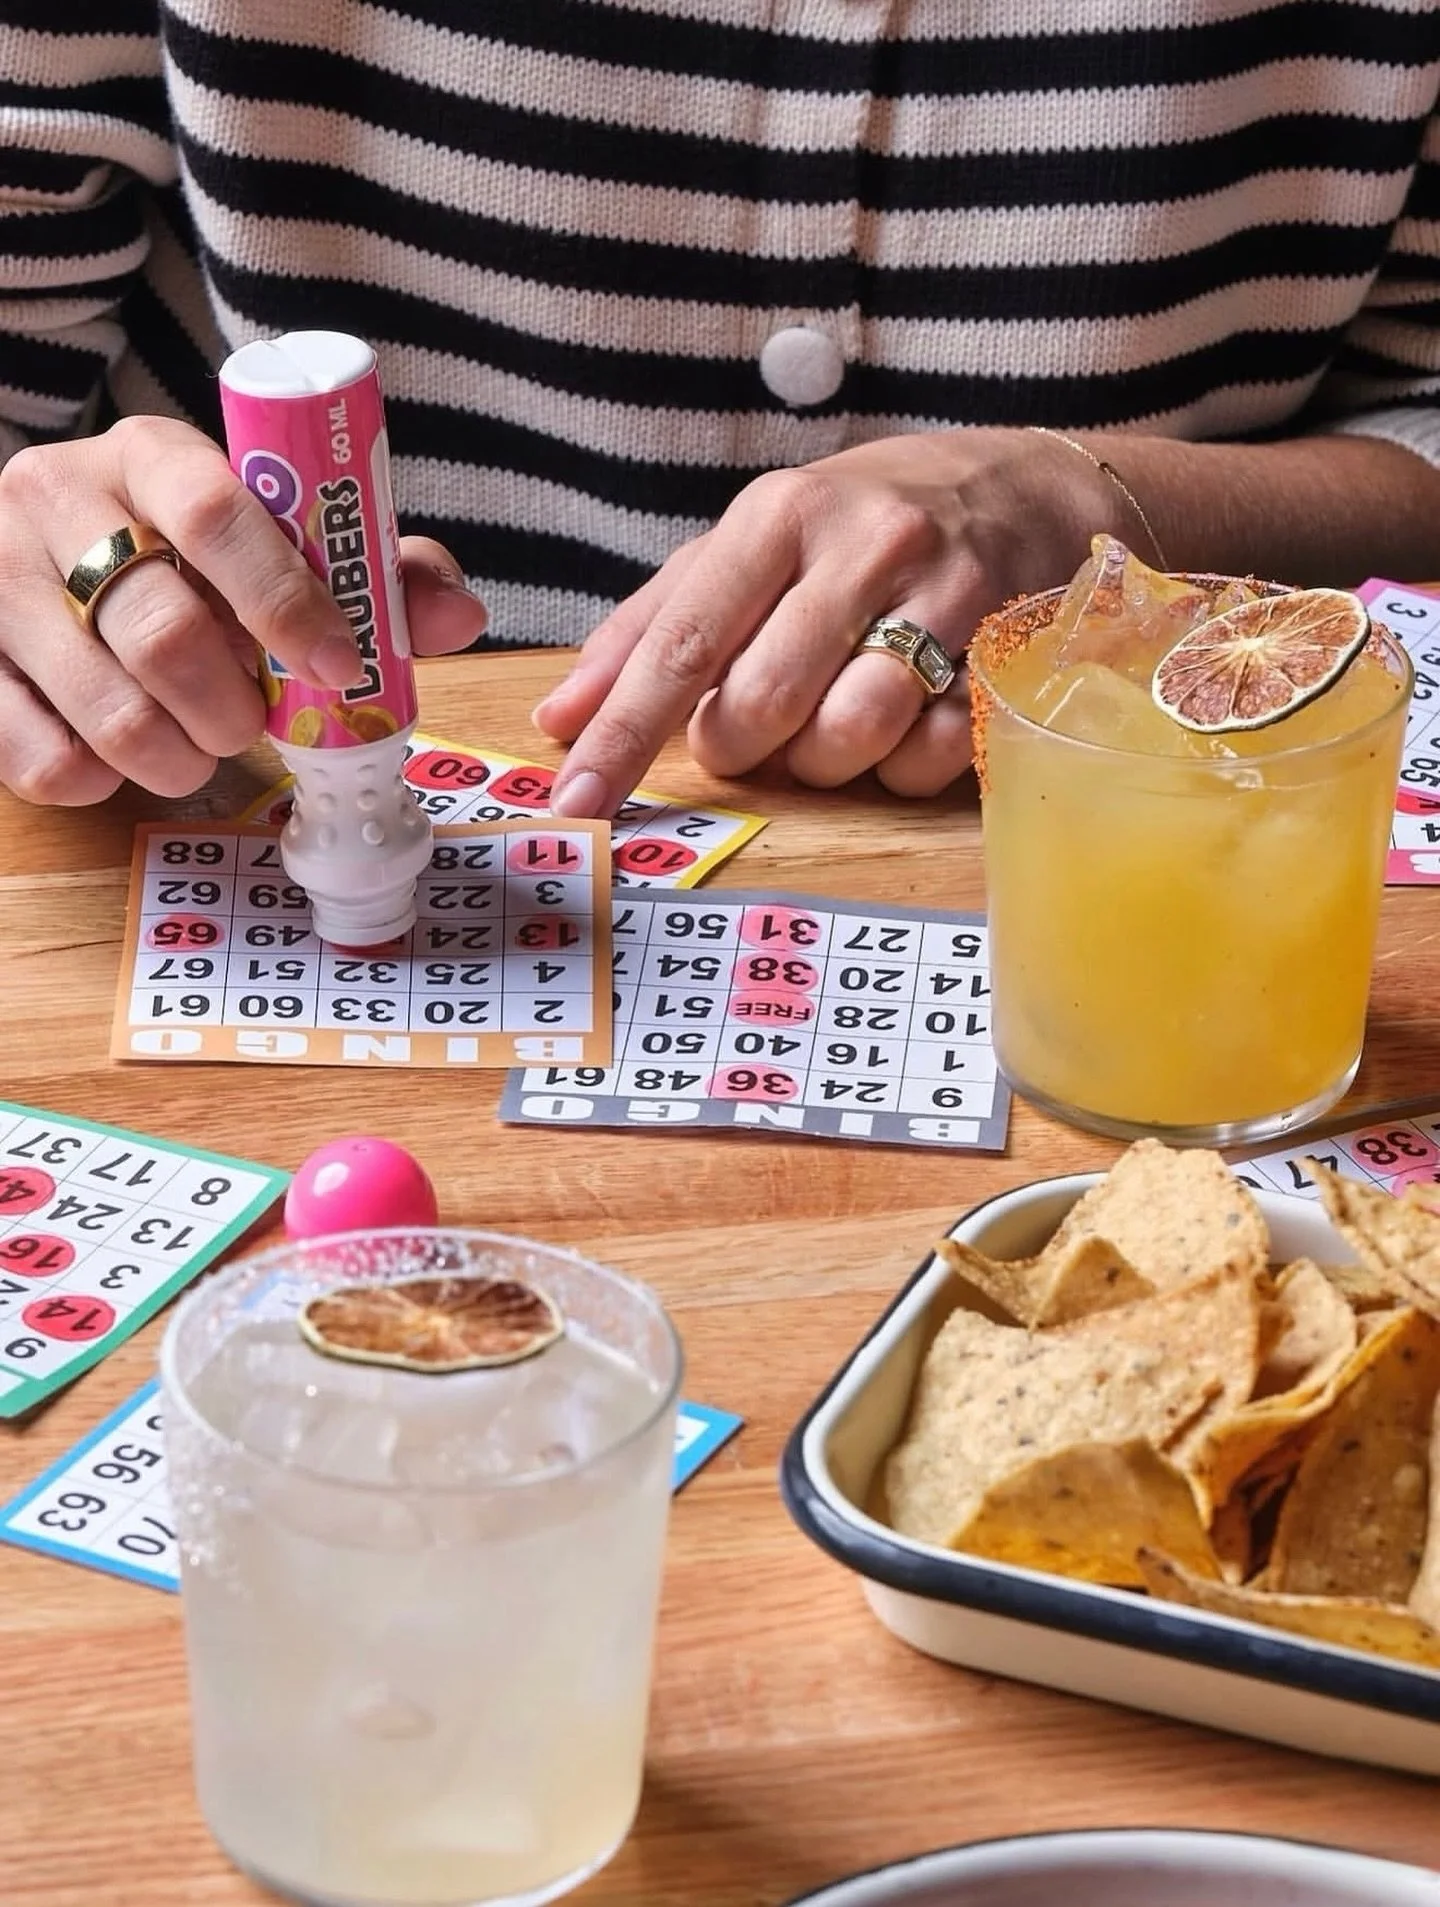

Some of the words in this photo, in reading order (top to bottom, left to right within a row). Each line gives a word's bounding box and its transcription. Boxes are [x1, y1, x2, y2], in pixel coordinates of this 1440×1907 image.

[328, 398, 348, 431] ML
[333, 432, 352, 465] 60
[429, 758, 491, 785] 60
[676, 817, 716, 837] 2
[162, 841, 224, 864] 68
[432, 845, 494, 870] 28
[528, 840, 578, 865] 11
[629, 844, 685, 868] 10
[158, 881, 221, 905] 62
[249, 884, 309, 909] 59
[429, 885, 493, 910] 22
[536, 881, 565, 905] 3
[154, 922, 218, 945] 65
[245, 925, 311, 946] 49
[518, 923, 580, 947] 13
[664, 912, 728, 939] 56
[761, 915, 819, 945] 31
[427, 927, 492, 949] 24
[844, 926, 910, 953] 27
[952, 934, 982, 958] 5
[149, 958, 214, 980] 67
[248, 960, 306, 980] 51
[334, 961, 398, 984] 32
[425, 962, 491, 985] 25
[532, 961, 566, 984] 4
[657, 955, 722, 981] 54
[749, 957, 812, 985] 38
[840, 967, 905, 993] 20
[929, 973, 991, 998] 14
[152, 994, 210, 1017] 61
[239, 995, 304, 1018] 60
[331, 998, 396, 1022] 33
[425, 1000, 490, 1024] 20
[534, 1000, 565, 1023] 2
[655, 994, 714, 1018] 51
[735, 1002, 811, 1021] FREE
[834, 1006, 899, 1030] 28
[925, 1011, 987, 1036] 10
[642, 1032, 707, 1054] 50
[734, 1032, 802, 1057] 40
[826, 1043, 889, 1067] 16
[943, 1050, 965, 1072] 1
[546, 1067, 605, 1087] 61
[634, 1069, 702, 1091] 48
[727, 1070, 794, 1095] 36
[820, 1079, 888, 1103] 24
[932, 1087, 963, 1108] 9
[7, 1132, 82, 1164] 37
[1356, 1131, 1428, 1166] 38
[88, 1153, 157, 1186] 17
[191, 1178, 232, 1205] 8
[47, 1195, 123, 1230] 24
[130, 1218, 195, 1250] 13
[0, 1238, 65, 1268] 16
[100, 1264, 140, 1289] 3
[36, 1300, 102, 1332] 14
[5, 1337, 47, 1359] 9
[92, 1444, 163, 1483] 56
[37, 1493, 106, 1531] 63
